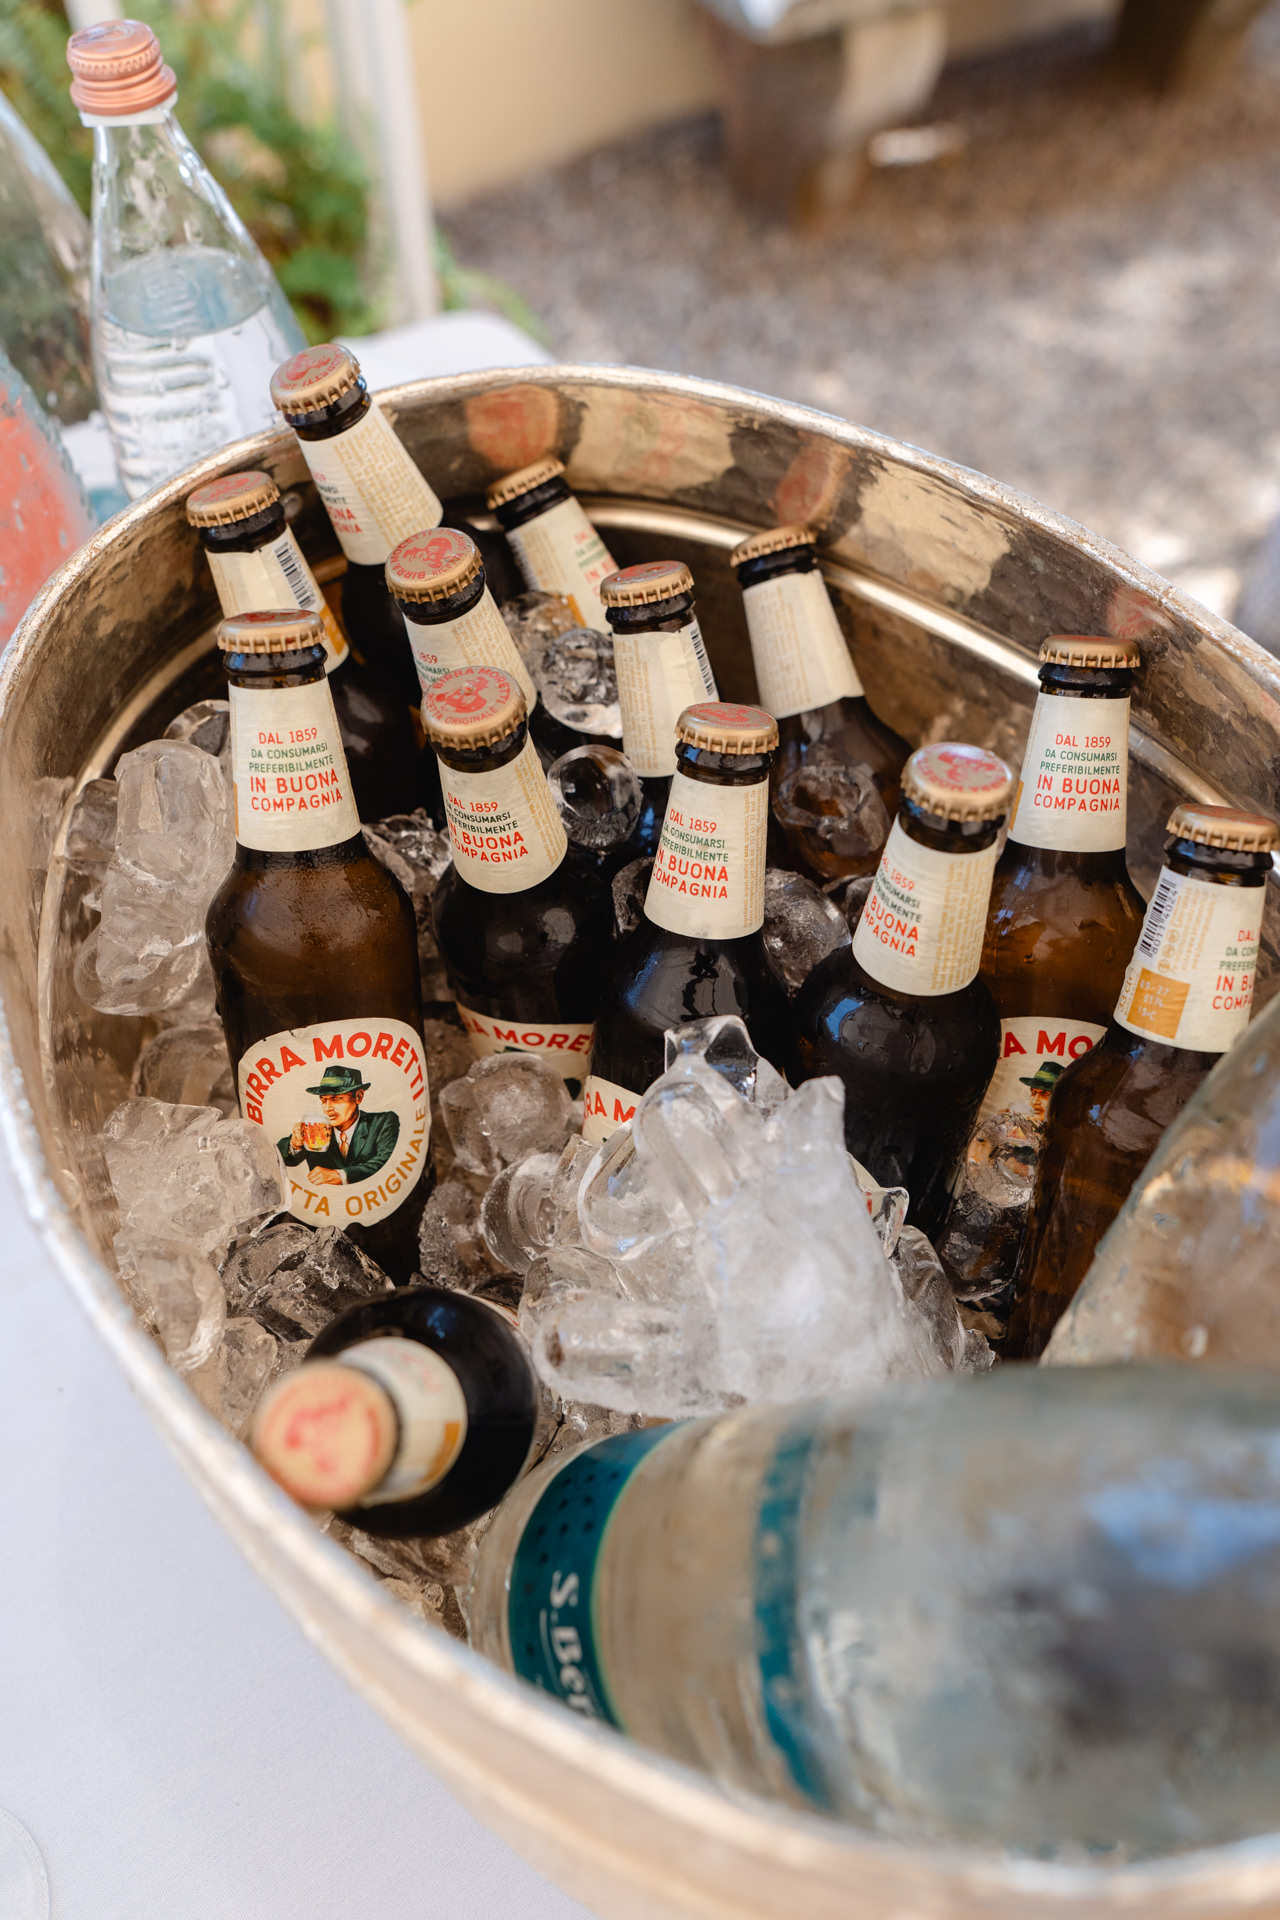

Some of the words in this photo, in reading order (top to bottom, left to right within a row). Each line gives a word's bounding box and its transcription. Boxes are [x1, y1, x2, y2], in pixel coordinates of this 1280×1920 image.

[432, 667, 475, 689] BIRRA
[477, 667, 511, 704] MORETTI
[258, 731, 283, 745] DAL
[289, 727, 318, 744] 1859
[1055, 733, 1079, 748] DAL
[1084, 735, 1111, 749] 1859
[251, 748, 263, 759] DA
[267, 741, 328, 759] CONSUMARSI
[1045, 748, 1056, 759] DA
[1060, 750, 1118, 762] CONSUMARSI
[249, 754, 334, 773] PREFERIBILMENTE
[1040, 761, 1121, 775] PREFERIBILMENTE
[250, 775, 266, 793] IN
[276, 767, 339, 794] BUONA
[1037, 774, 1053, 791] IN
[1062, 777, 1121, 795] BUONA
[251, 788, 343, 812] COMPAGNIA
[447, 791, 466, 811] DAL
[469, 801, 498, 813] 1859
[1034, 793, 1121, 812] COMPAGNIA
[454, 807, 511, 824] CONSUMARSI
[669, 808, 685, 827] DAL
[689, 817, 717, 834] 1859
[462, 830, 525, 849] BUONA
[670, 827, 726, 849] CONSUMARSI
[668, 855, 729, 882] BUONA
[890, 868, 915, 892] 1859
[870, 895, 919, 942] BUONA
[1225, 946, 1238, 957] DA
[1215, 974, 1235, 992] IN
[492, 1024, 593, 1056] MORE
[1036, 1029, 1094, 1060] MO
[245, 1045, 307, 1126] BIRRA
[312, 1031, 425, 1101] MORETTI
[584, 1091, 607, 1120] RA
[289, 1180, 331, 1217] TTA
[345, 1107, 426, 1217] ORIGINALE
[549, 1569, 595, 1719] S.Ber
